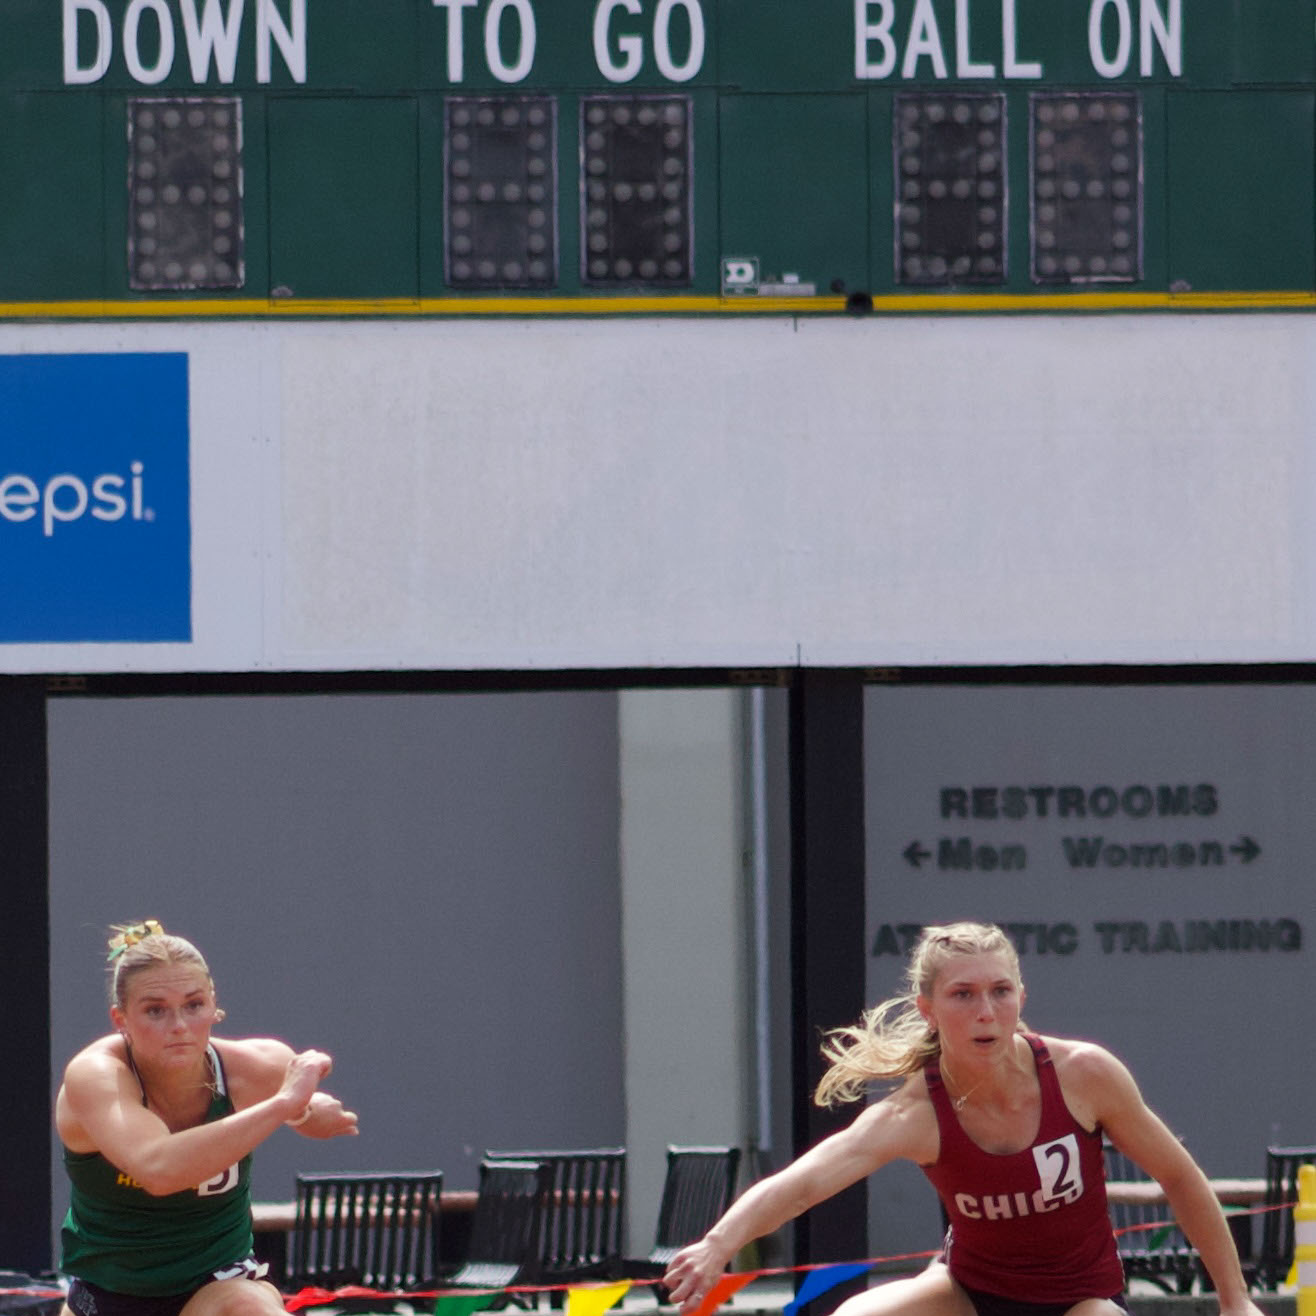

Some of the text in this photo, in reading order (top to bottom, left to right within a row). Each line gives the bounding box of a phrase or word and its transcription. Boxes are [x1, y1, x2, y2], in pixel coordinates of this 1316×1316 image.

[63, 0, 308, 84] DOWN
[433, 0, 706, 83] TO GO
[854, 0, 1184, 80] BALL ON
[939, 784, 1219, 820] RESTROOMS
[937, 835, 1226, 871] Men Women
[872, 918, 1303, 957] ATTIC TRAINING
[1044, 1143, 1075, 1196] 2
